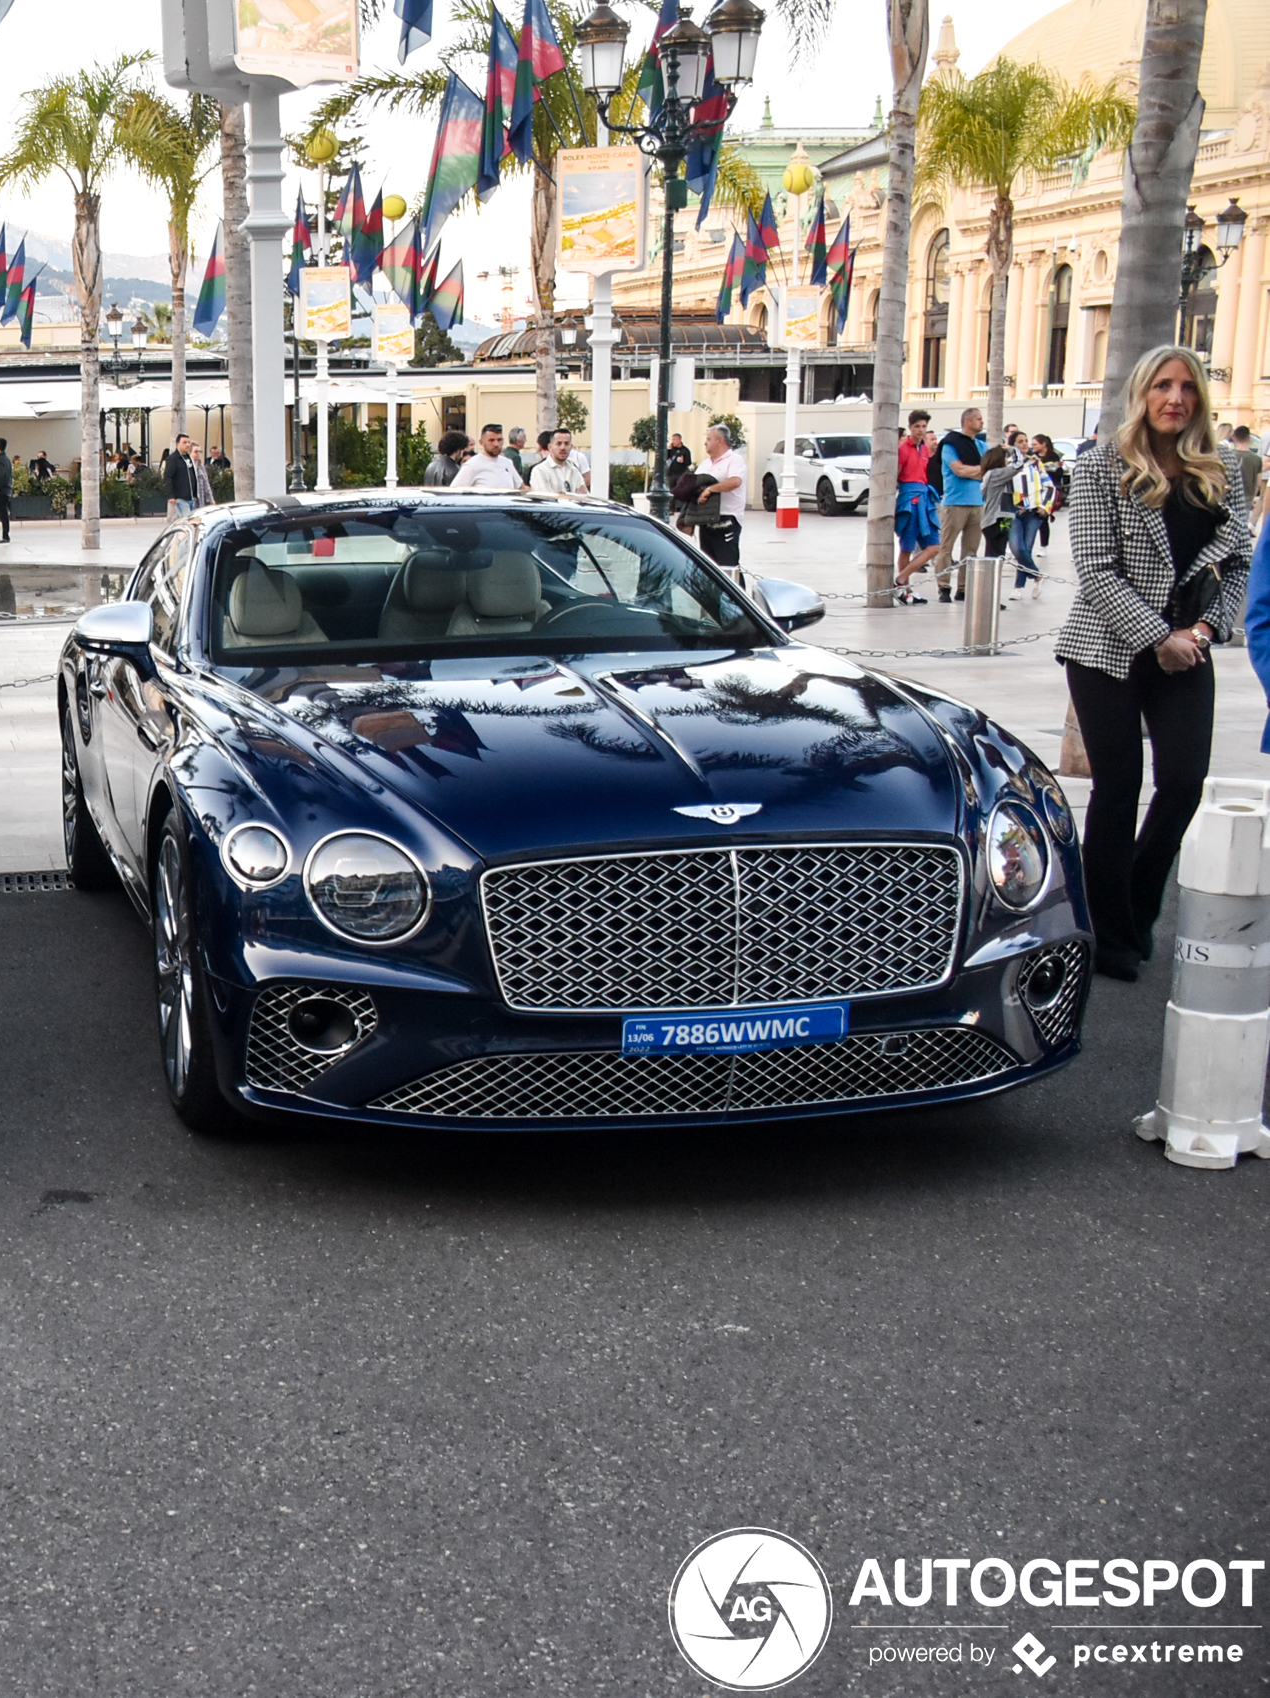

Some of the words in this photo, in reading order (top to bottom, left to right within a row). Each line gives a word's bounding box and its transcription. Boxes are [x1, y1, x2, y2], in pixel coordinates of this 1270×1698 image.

[562, 154, 585, 162] ROLEX
[586, 151, 637, 160] MONTE-CARLO
[660, 1016, 810, 1046] 7886WWMC
[627, 1033, 655, 1043] 13/06
